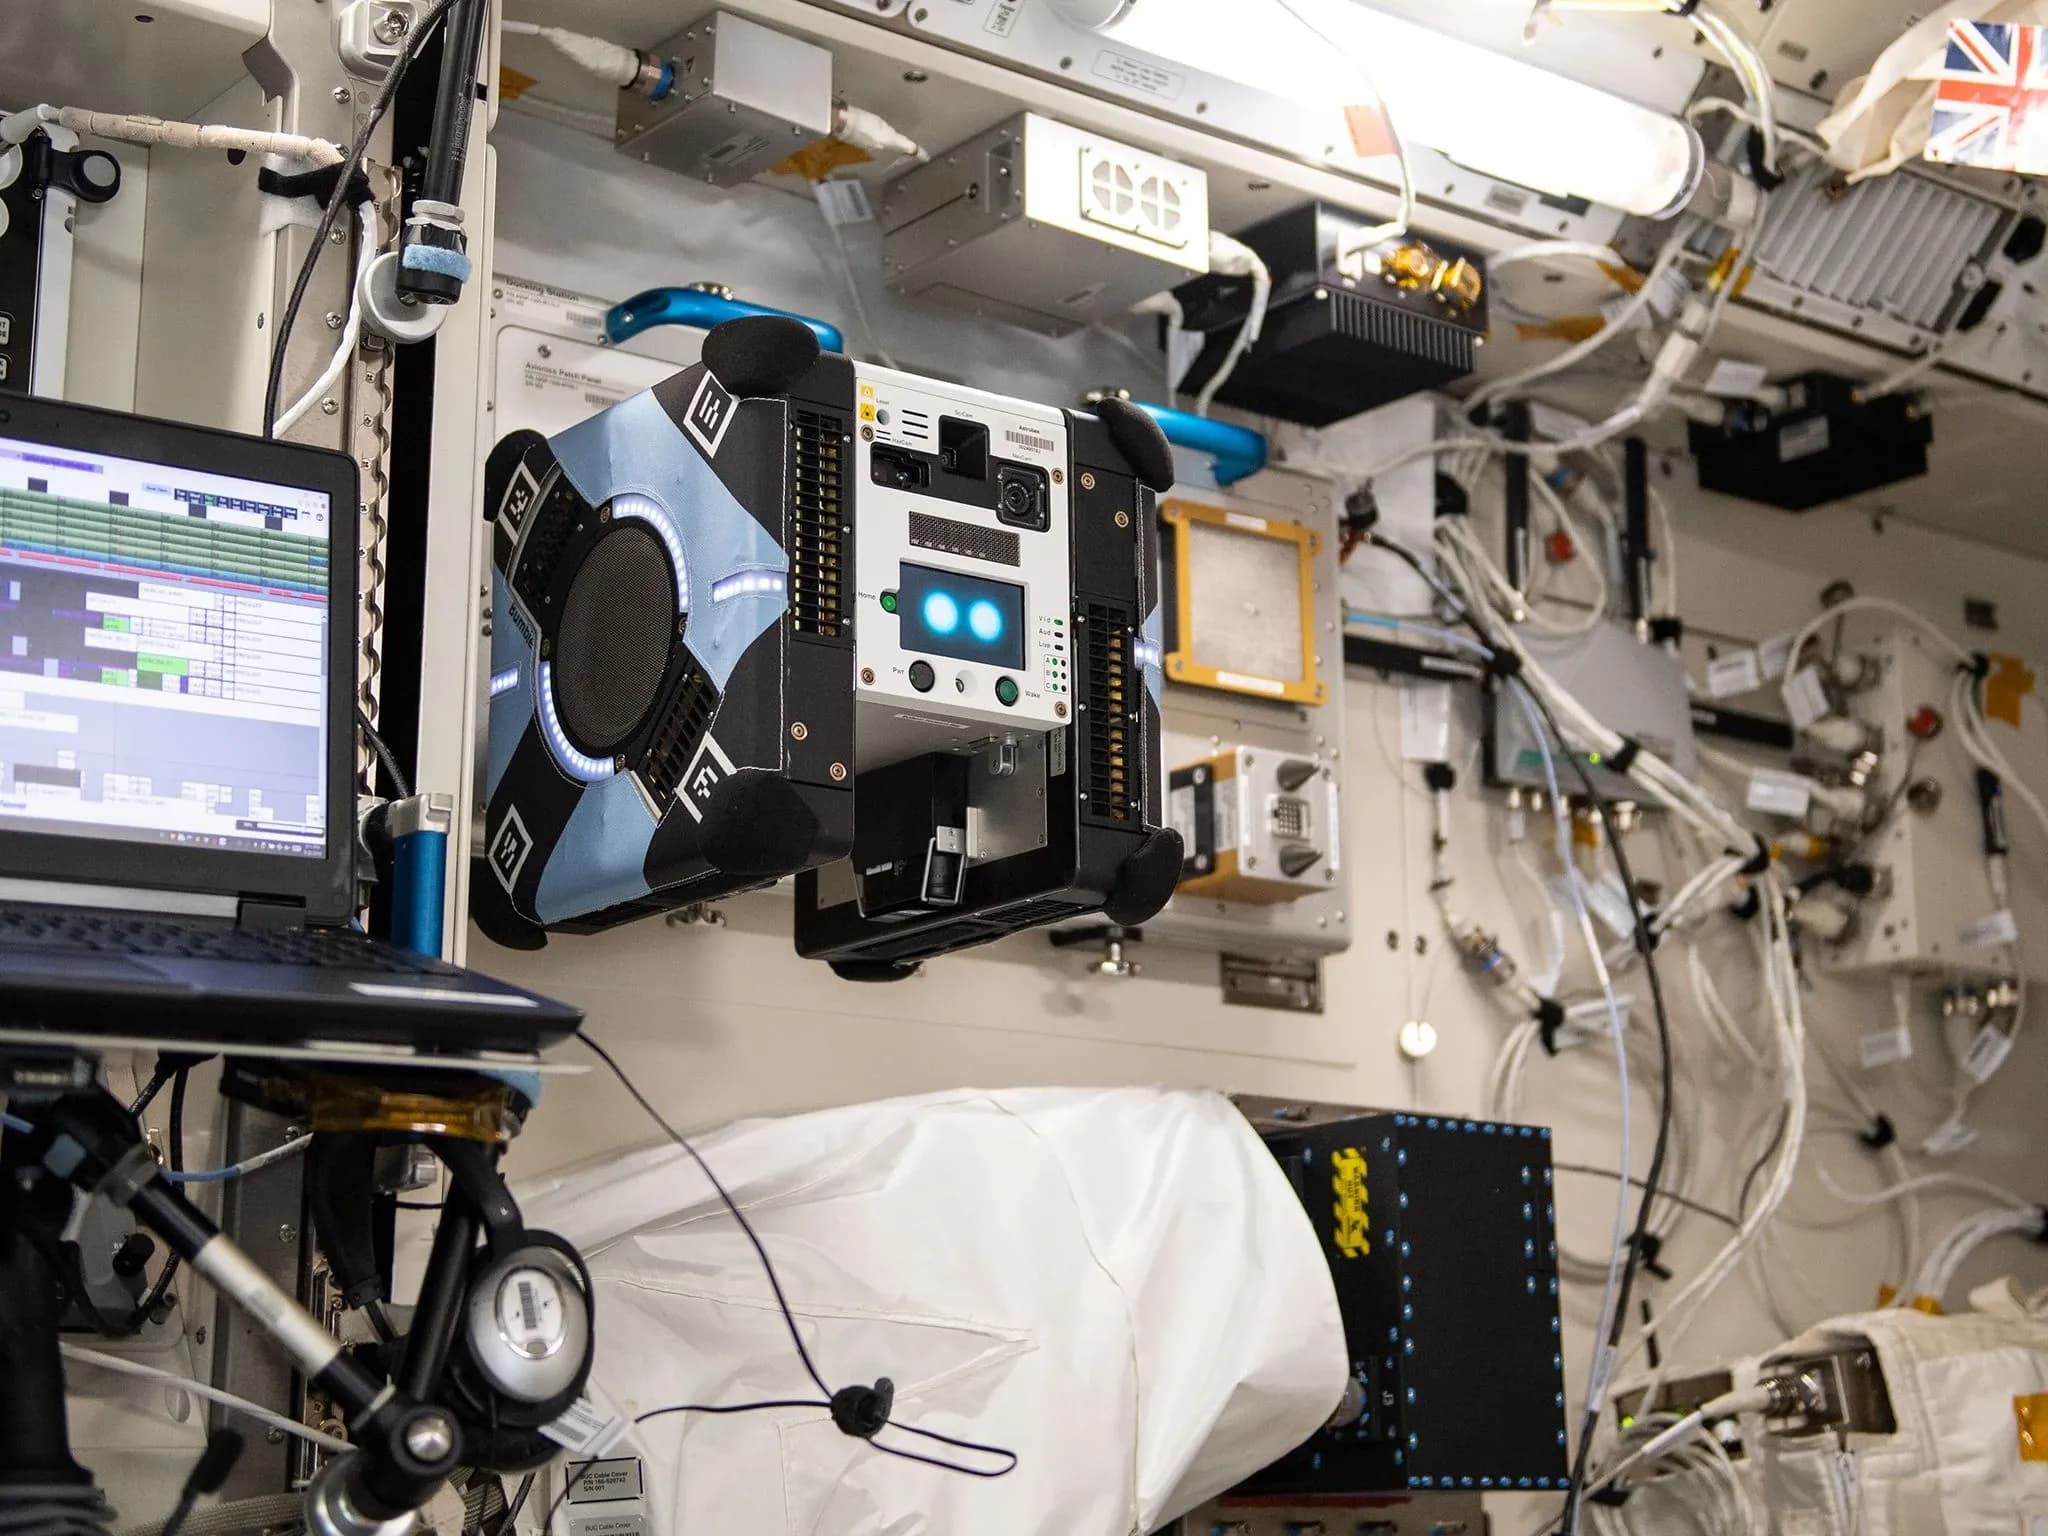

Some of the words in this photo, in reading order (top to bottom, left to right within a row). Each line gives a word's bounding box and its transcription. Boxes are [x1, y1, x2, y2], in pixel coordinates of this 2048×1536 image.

[858, 591, 876, 601] Home
[1038, 615, 1051, 624] Vid
[508, 604, 534, 650] Bumble
[1038, 628, 1051, 636] Aud
[1038, 641, 1051, 649] Live
[892, 666, 905, 675] Pwr
[1025, 690, 1041, 699] Wake
